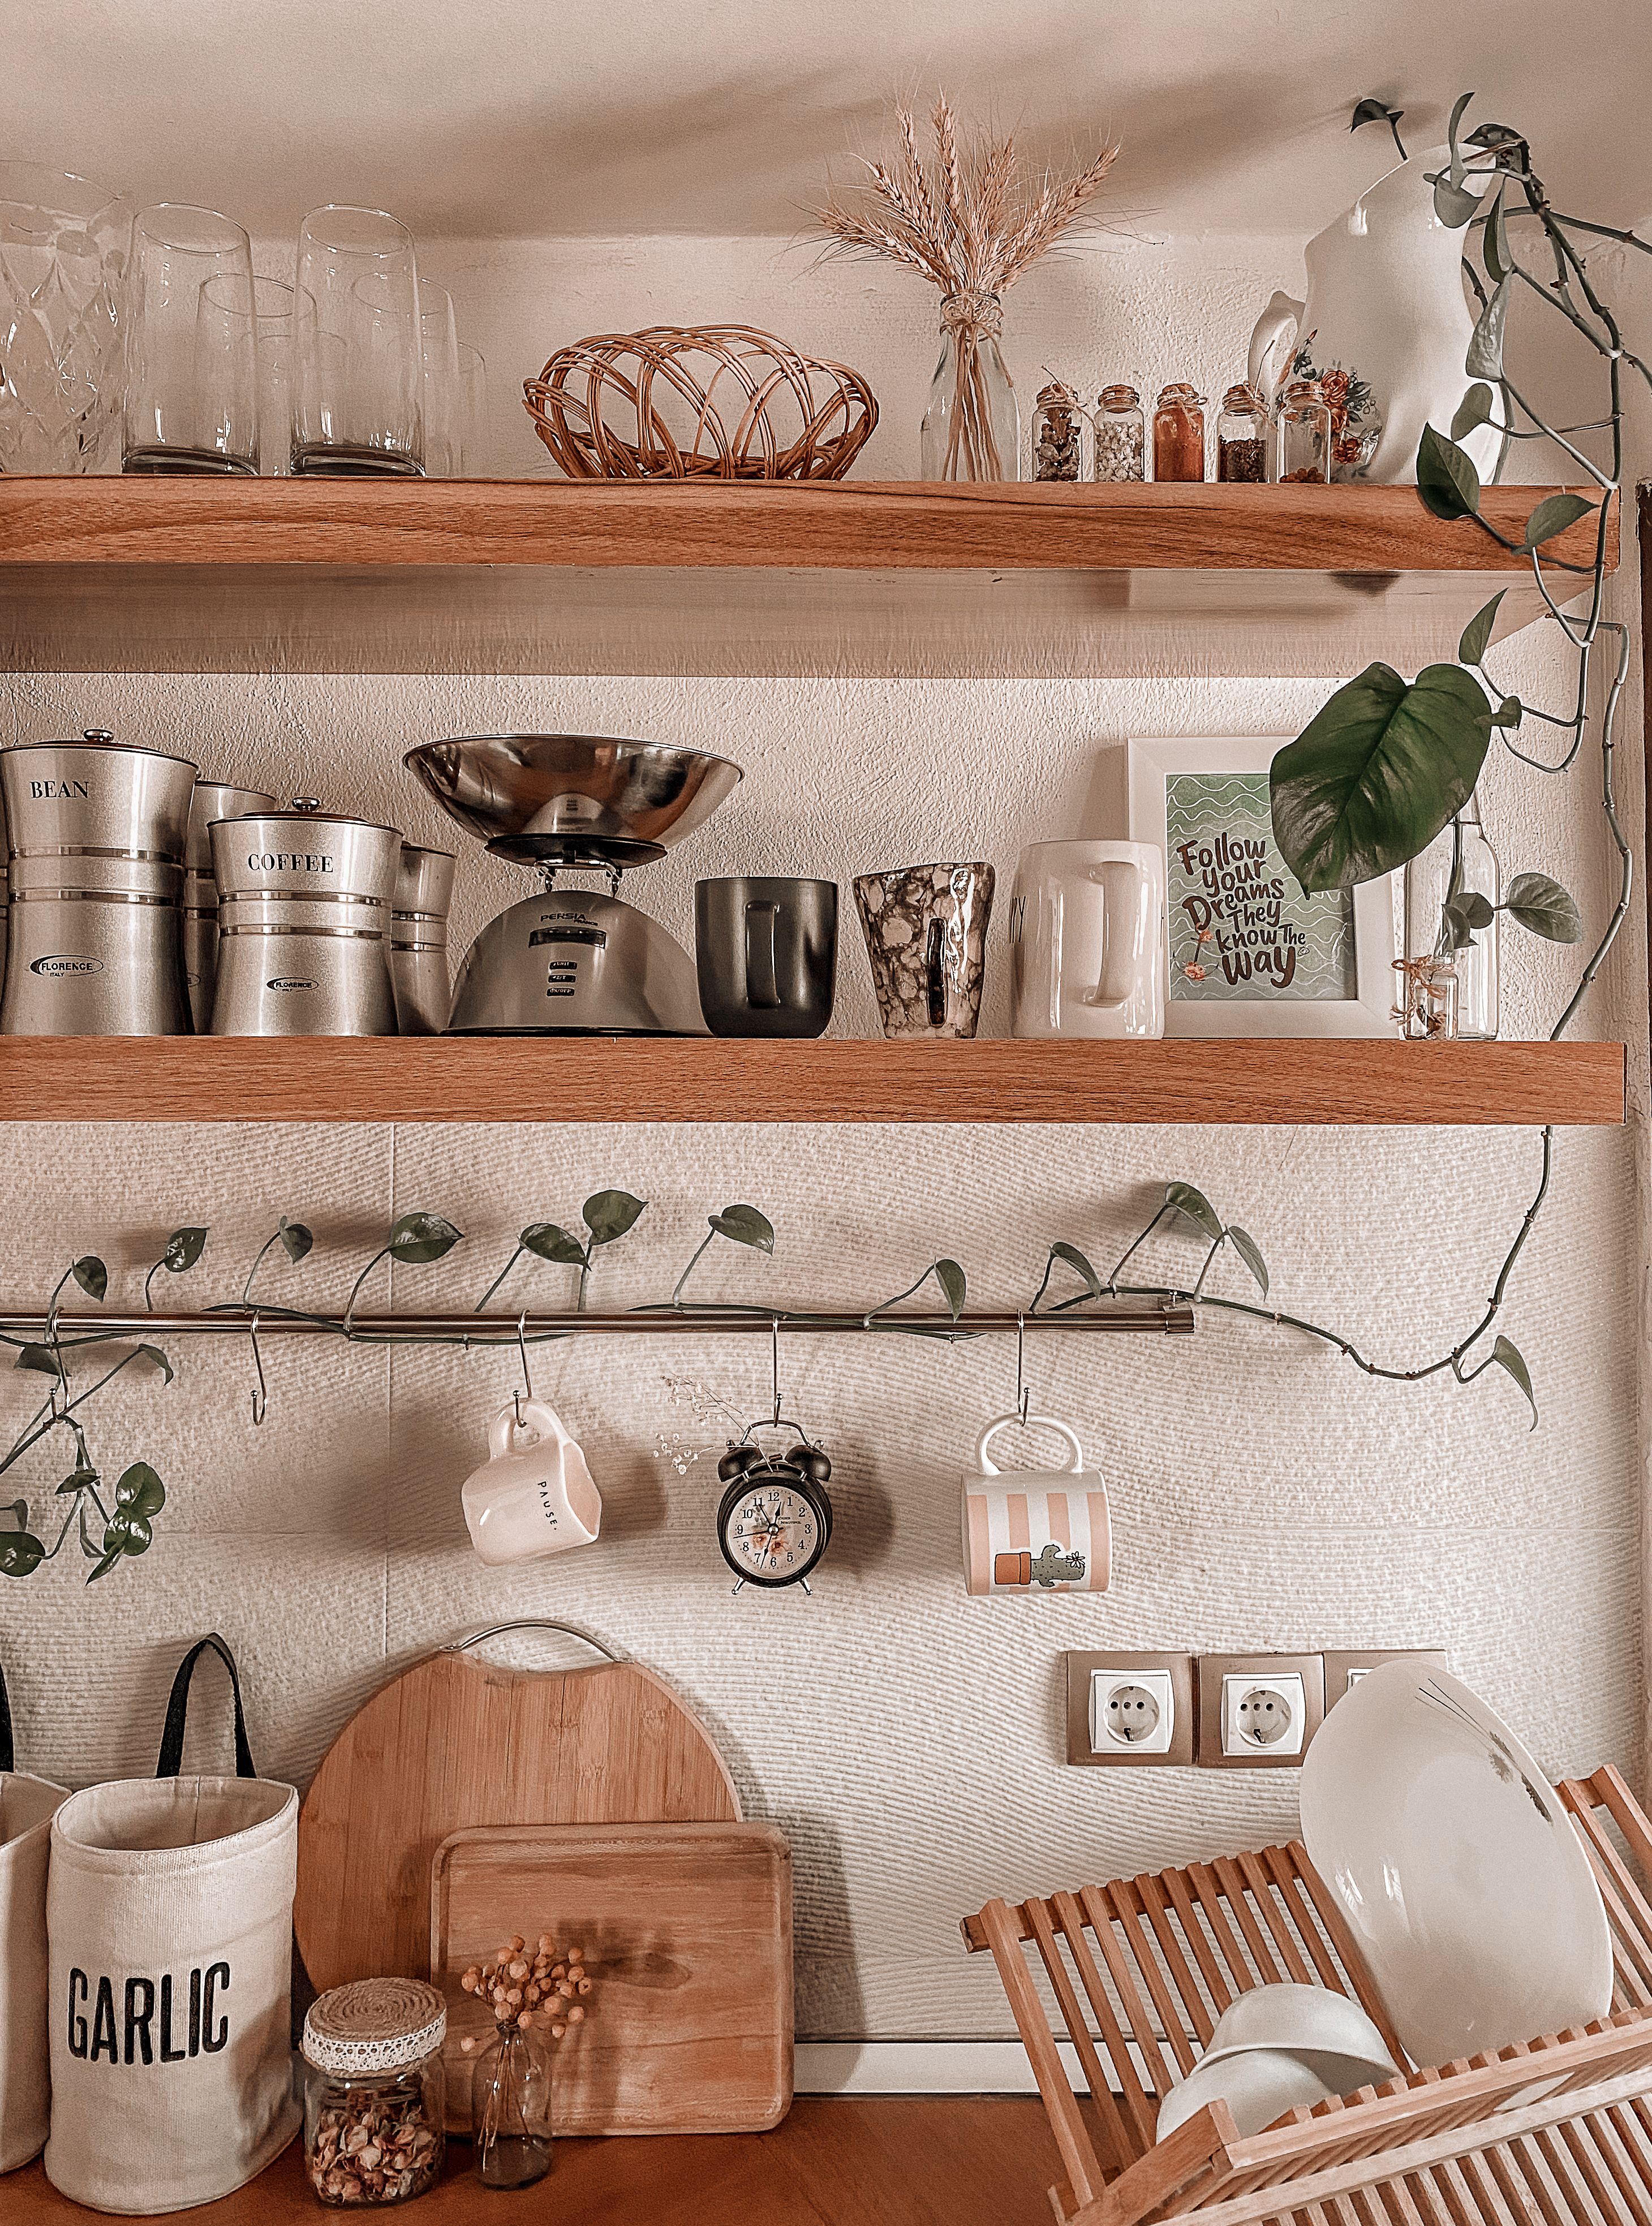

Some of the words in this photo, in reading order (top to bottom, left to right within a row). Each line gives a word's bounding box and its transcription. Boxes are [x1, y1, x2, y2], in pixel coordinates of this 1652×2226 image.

[30, 781, 89, 799] BEAN
[1176, 832, 1266, 875] Follow
[248, 854, 333, 873] COFFEE
[1202, 859, 1267, 898] your
[1182, 878, 1284, 935] Dreams
[540, 913, 587, 922] PERSIA
[1227, 900, 1281, 933] They
[1215, 929, 1277, 954] know
[1277, 923, 1306, 946] The
[41, 962, 93, 971] FLORENCE
[752, 1497, 764, 1507] 11
[768, 1492, 780, 1501] 12
[787, 1496, 793, 1506] 1
[742, 1509, 753, 1519] 10
[798, 1507, 806, 1517] 2
[737, 1524, 743, 1535] 9
[804, 1523, 811, 1534] 3
[742, 1542, 750, 1552] 8
[797, 1539, 805, 1550] 4
[754, 1553, 762, 1564] 7
[770, 1557, 777, 1567] 6
[786, 1552, 794, 1562] 5
[67, 1961, 231, 2066] GARLIC
